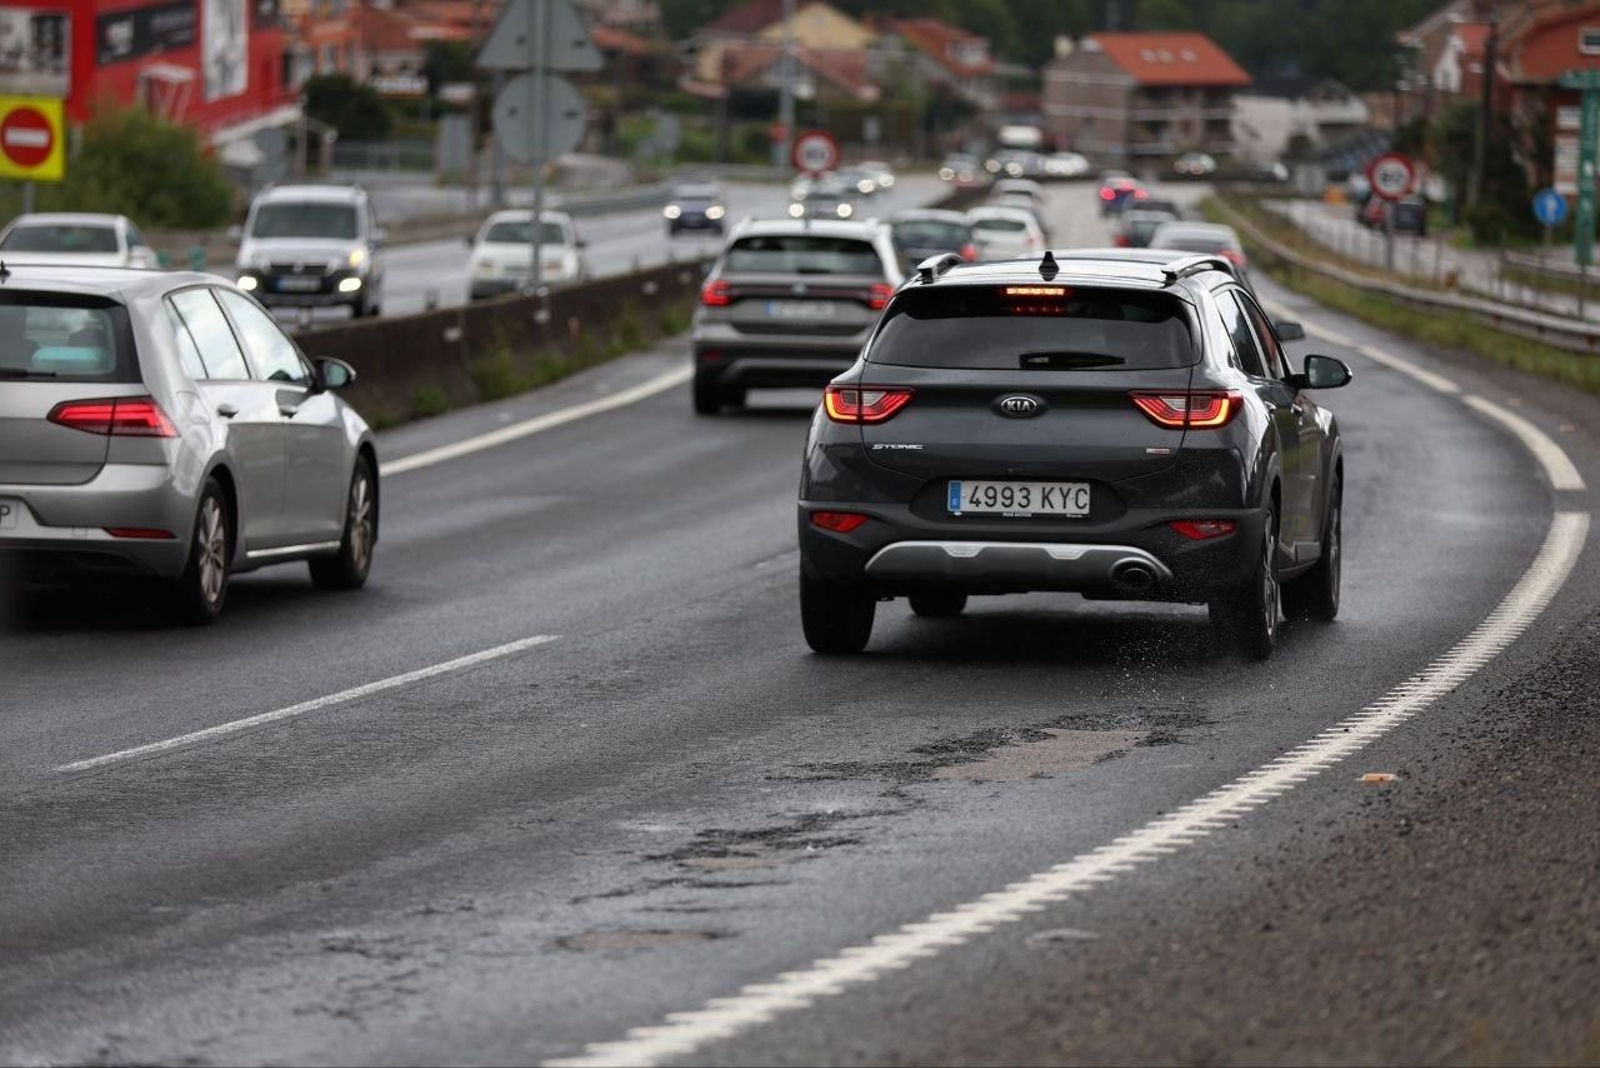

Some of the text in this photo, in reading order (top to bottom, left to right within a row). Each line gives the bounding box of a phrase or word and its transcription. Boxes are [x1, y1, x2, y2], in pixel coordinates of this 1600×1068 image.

[1006, 400, 1031, 411] KIA
[969, 485, 1088, 510] 4993 KYC
